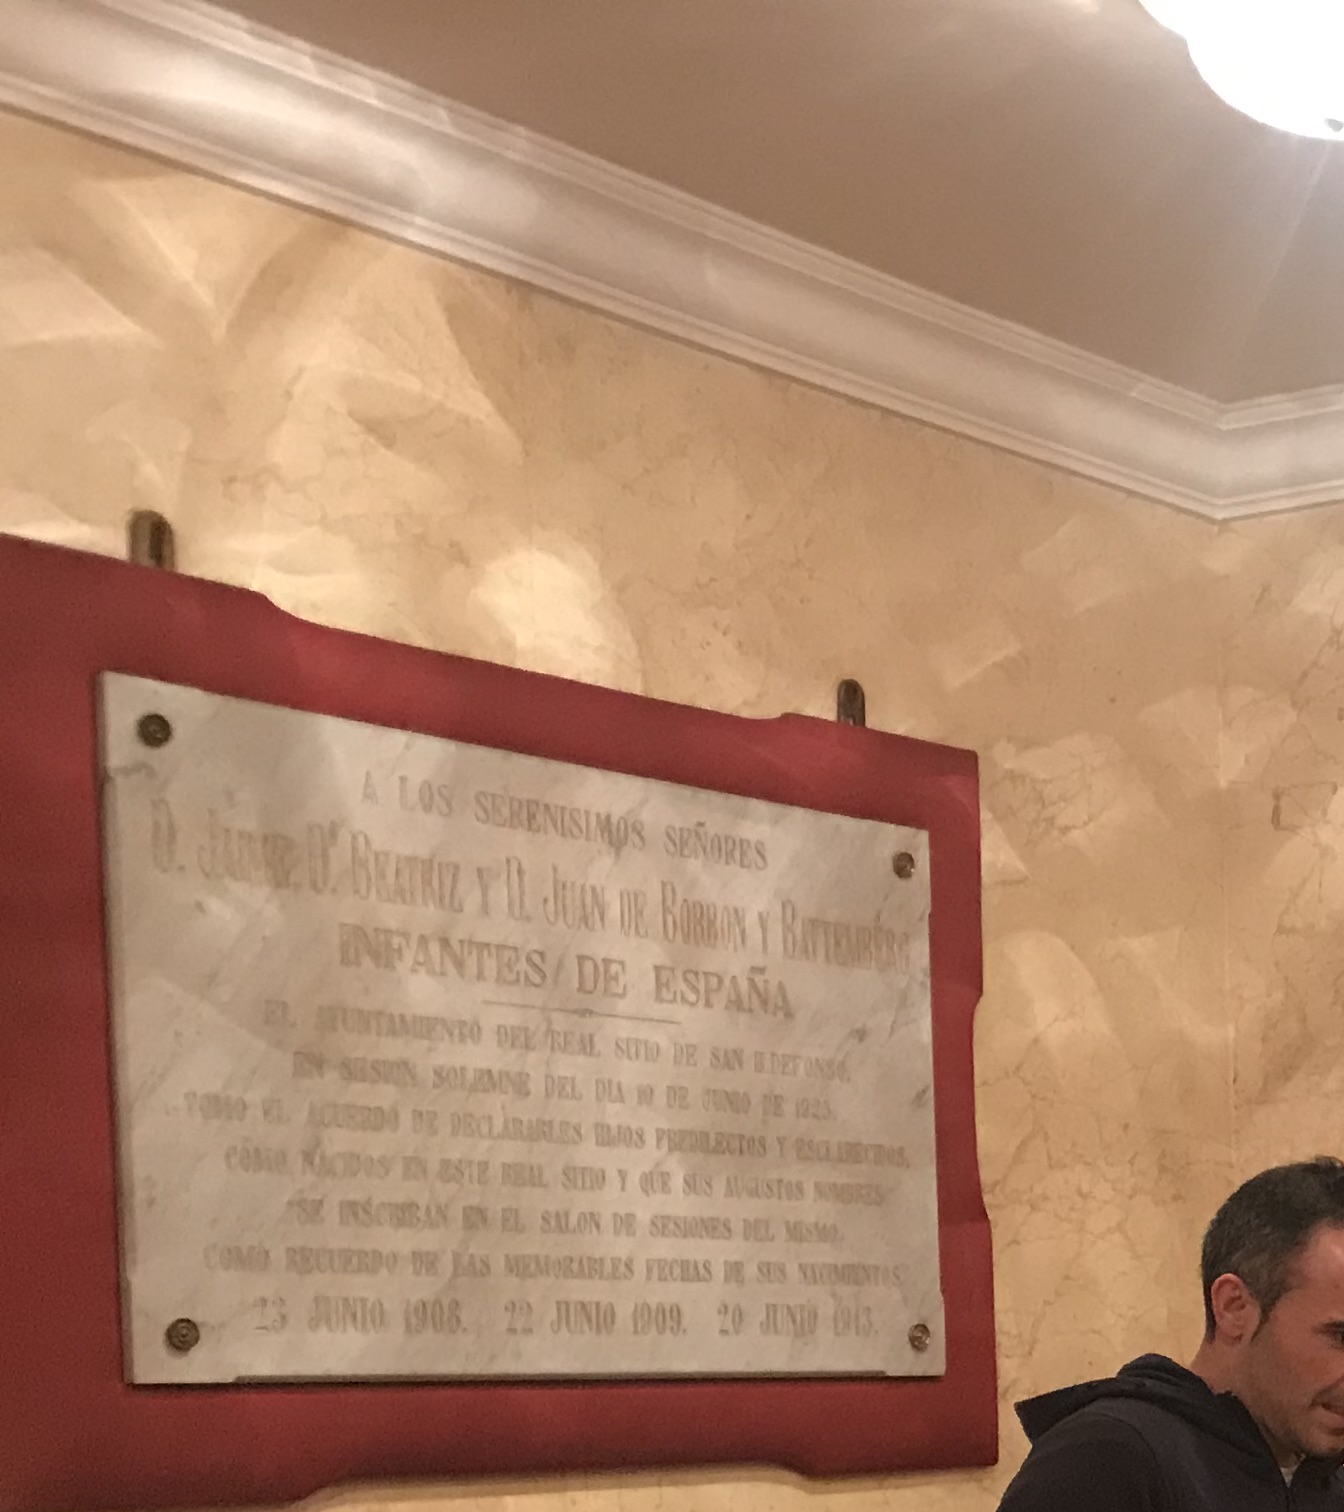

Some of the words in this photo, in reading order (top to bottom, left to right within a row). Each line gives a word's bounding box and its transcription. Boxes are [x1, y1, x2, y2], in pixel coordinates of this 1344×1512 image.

[361, 770, 379, 806] A
[398, 774, 453, 818] LOS
[664, 820, 768, 871] SEÑORES
[542, 863, 606, 932] JUAN
[619, 888, 648, 938] DE
[757, 908, 770, 956] Y
[338, 920, 547, 989] INFANTES
[575, 953, 628, 1000] DE
[653, 964, 796, 1020] ESPAÑA
[496, 1024, 536, 1051] DEL
[549, 1029, 601, 1058] REAL
[613, 1037, 661, 1063] SITIO
[673, 1042, 699, 1068] DE
[709, 1046, 745, 1071] SAN
[543, 1074, 583, 1102] DEL
[594, 1078, 626, 1104] DIA
[666, 1085, 691, 1110] DE
[761, 1094, 784, 1118] DE
[411, 1109, 439, 1138] DE
[560, 1165, 607, 1192] SITIO
[617, 1168, 629, 1193] Y
[638, 1169, 672, 1198] QUE
[682, 1172, 714, 1199] SUS
[500, 1207, 527, 1234] EL
[539, 1209, 601, 1236] SALON
[611, 1212, 637, 1238] DE
[649, 1215, 733, 1241] SESIONES
[741, 1218, 776, 1243] DEL
[411, 1250, 439, 1277] DE
[645, 1257, 713, 1284] FECHAS
[722, 1260, 745, 1285] DE
[756, 1261, 787, 1285] SUS
[307, 1295, 386, 1334] JUNIO
[503, 1300, 534, 1336] 22
[549, 1299, 616, 1336] JUNIO
[717, 1302, 744, 1337] 20
[759, 1303, 819, 1339] JUNIO
